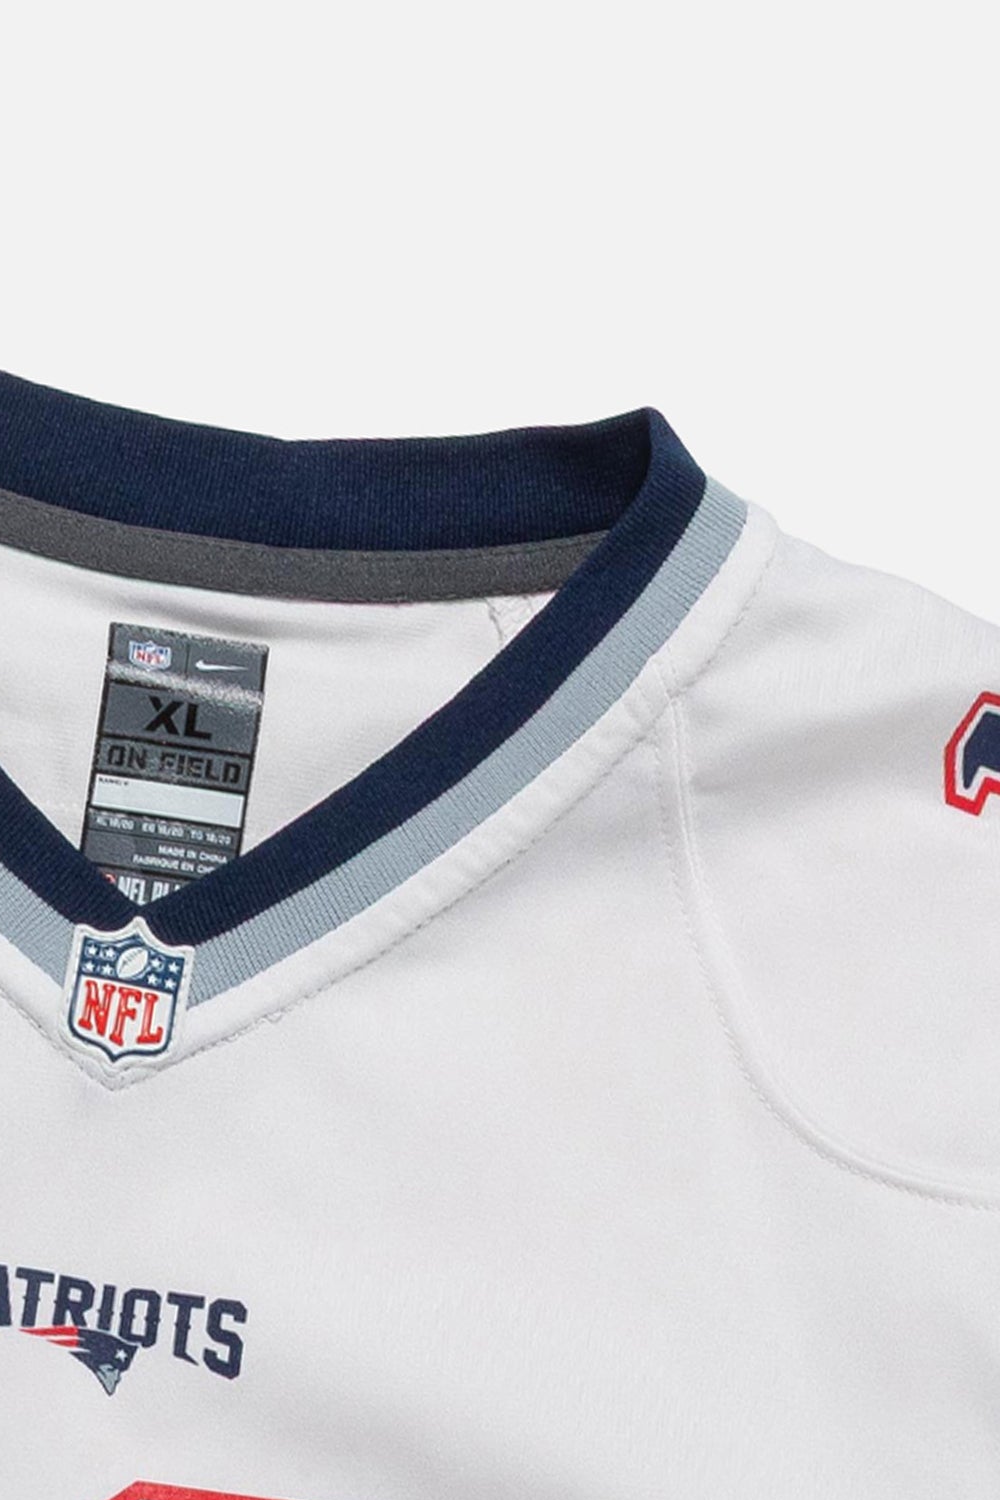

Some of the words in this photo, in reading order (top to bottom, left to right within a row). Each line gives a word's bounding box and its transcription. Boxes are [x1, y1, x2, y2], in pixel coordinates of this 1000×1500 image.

[144, 695, 212, 740] XL
[107, 745, 148, 769] ON
[159, 751, 242, 783] FIELD
[158, 845, 185, 858] MADE
[186, 850, 198, 860] IN
[199, 851, 228, 864] CHINA
[181, 861, 194, 872] EN
[118, 876, 148, 906] NFL
[78, 980, 164, 1047] NFL
